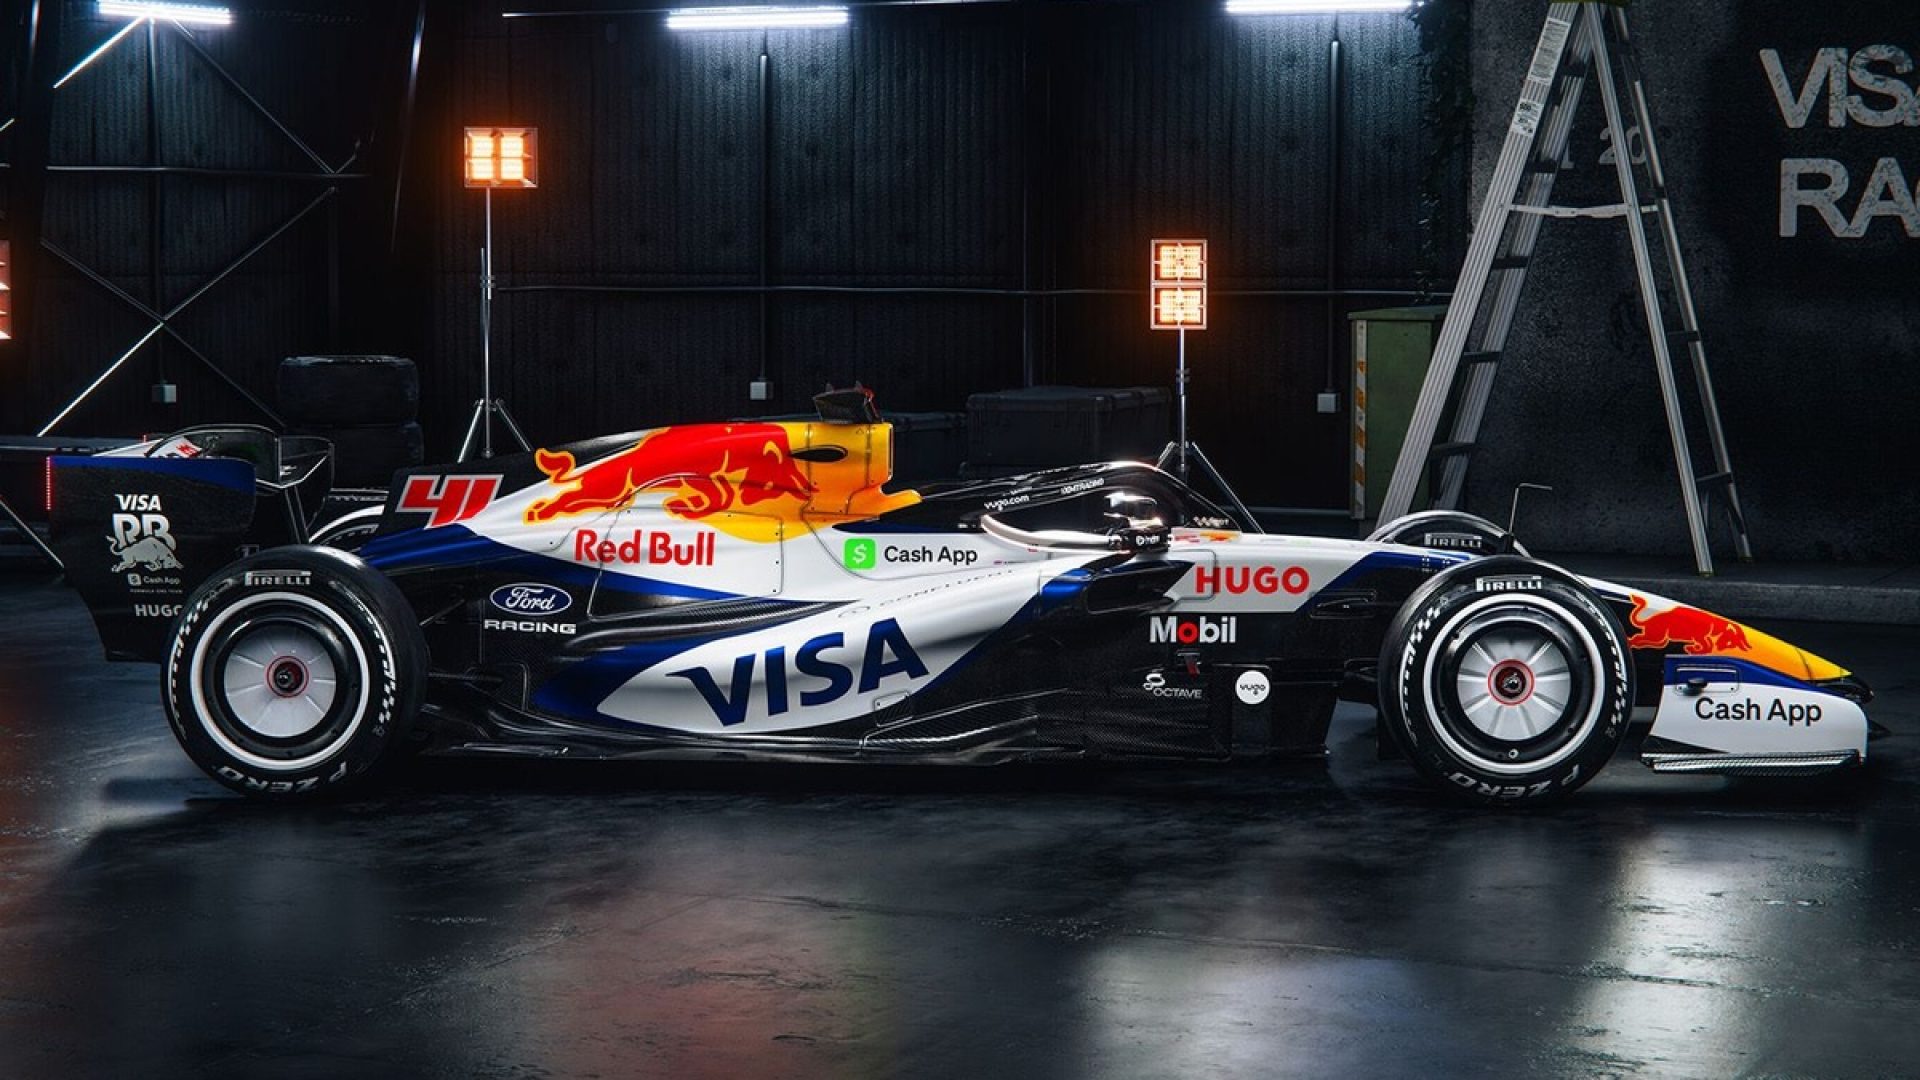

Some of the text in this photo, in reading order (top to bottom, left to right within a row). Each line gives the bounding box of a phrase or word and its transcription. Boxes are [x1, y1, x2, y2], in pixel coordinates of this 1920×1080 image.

[1759, 45, 1920, 128] VIS
[1779, 157, 1920, 237] RA
[114, 493, 162, 511] VISA
[574, 529, 716, 566] Red Bull
[1424, 532, 1483, 549] PIRELLI
[884, 545, 934, 563] Cash
[937, 546, 979, 566] App
[244, 570, 313, 587] PIRELLI
[1195, 566, 1310, 595] HUGO
[1475, 574, 1542, 593] PIRELLI
[504, 586, 555, 612] Ford
[483, 617, 577, 635] RACING
[1149, 616, 1238, 644] Mobil
[664, 617, 931, 728] VISA
[1153, 686, 1203, 699] OCTAVE
[1694, 697, 1823, 727] Cash App
[217, 765, 320, 793] ZERO
[1447, 772, 1552, 799] ZERO
